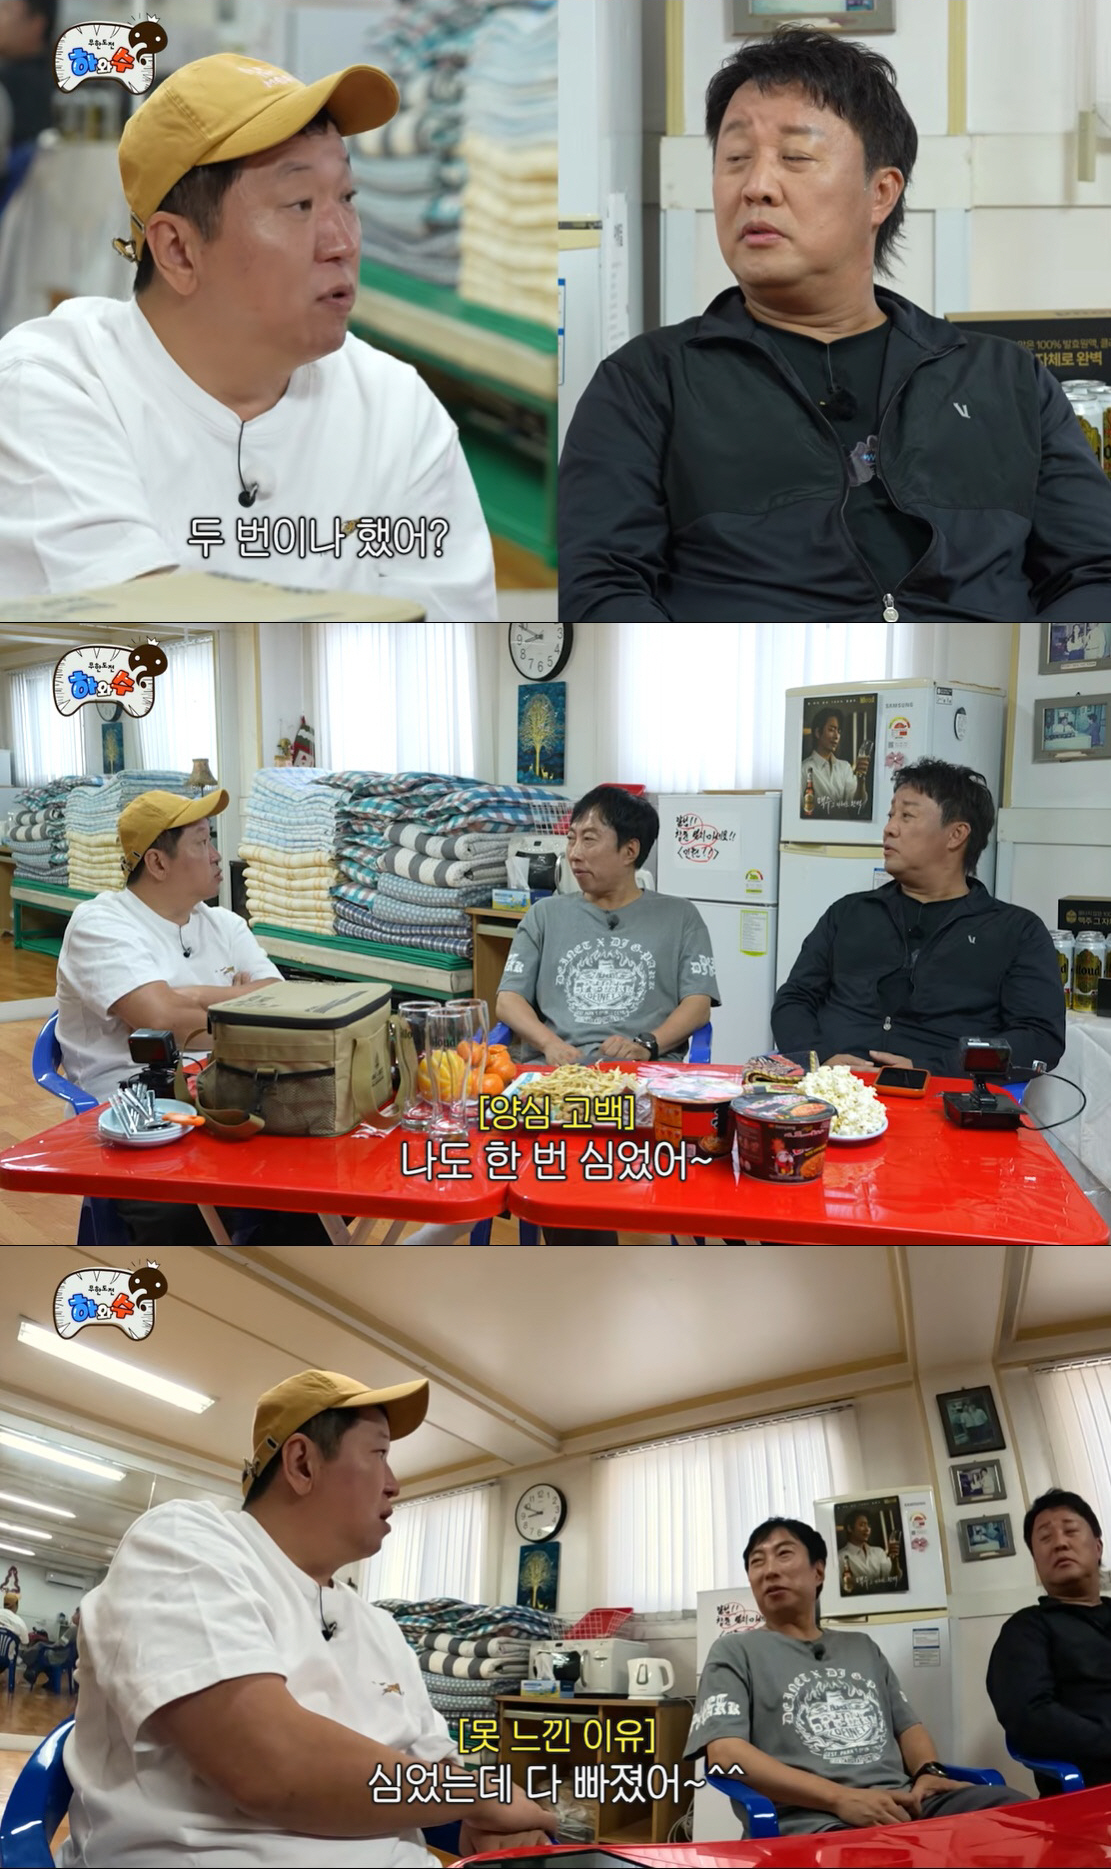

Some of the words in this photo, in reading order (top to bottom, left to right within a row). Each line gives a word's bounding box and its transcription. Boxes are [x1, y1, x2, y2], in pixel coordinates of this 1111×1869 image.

[1036, 339, 1062, 349] 100%
[1036, 352, 1074, 367] 자체로
[1076, 351, 1103, 366] 완벽
[885, 701, 914, 709] SAMSUNG
